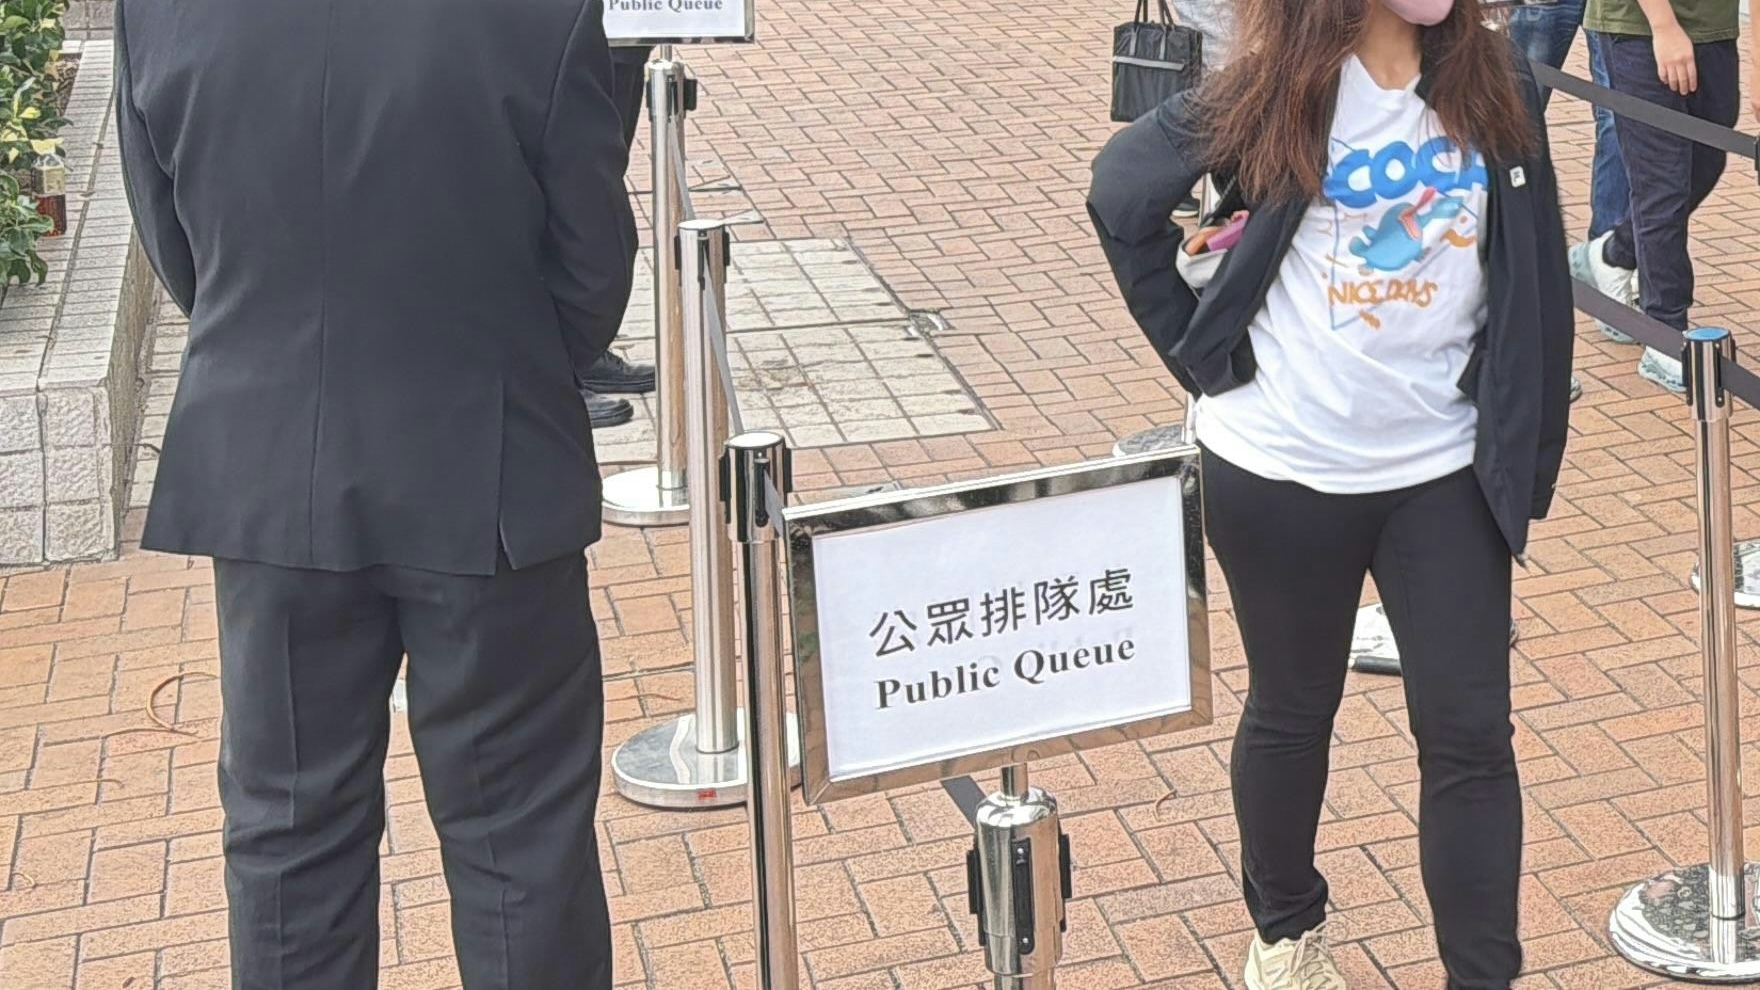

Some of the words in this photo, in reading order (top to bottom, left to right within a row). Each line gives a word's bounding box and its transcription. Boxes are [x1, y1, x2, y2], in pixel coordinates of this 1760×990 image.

[1323, 136, 1488, 208] COC
[868, 567, 1135, 658] 公眾排隊處
[875, 662, 1000, 711] Public
[1013, 637, 1136, 685] Queue
